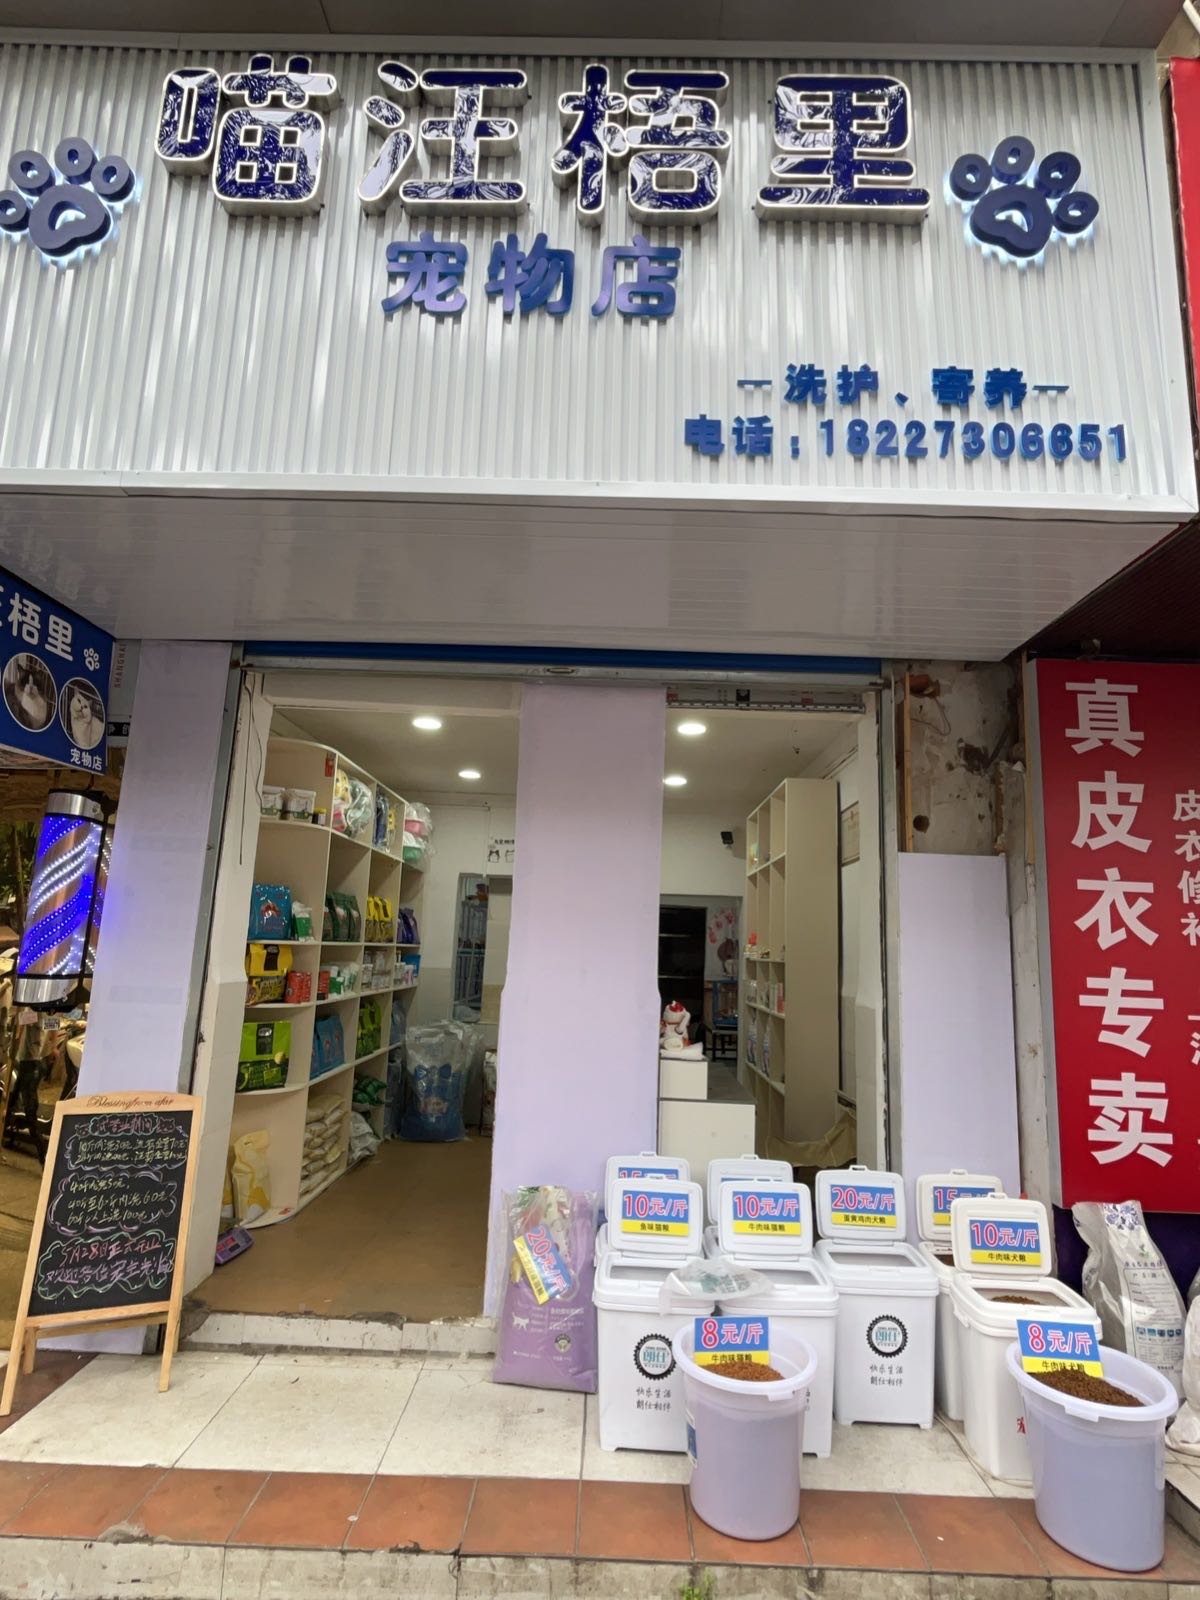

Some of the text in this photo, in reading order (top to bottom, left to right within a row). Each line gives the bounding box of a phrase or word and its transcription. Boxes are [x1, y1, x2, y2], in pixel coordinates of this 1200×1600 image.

[155, 54, 931, 222] 喵汪梧里
[382, 231, 682, 318] 宠物店
[0, 585, 74, 662] 梧里
[70, 748, 103, 771] 宠物店
[1065, 678, 1174, 1168] 真皮衣专卖
[623, 1194, 689, 1218] 10元/斤
[733, 1195, 799, 1219] 10元/斤
[831, 1187, 895, 1212] 20元/斤
[640, 1223, 670, 1233] 鱼味猫粮
[748, 1223, 786, 1233] 牛肉味猫粮
[970, 1222, 1039, 1249] 10元/斤
[526, 1224, 570, 1294] 20元/斤
[987, 1253, 1027, 1263] 牛肉味犬粮
[701, 1318, 764, 1349] 8元/斤
[1028, 1323, 1092, 1356] 8元/斤
